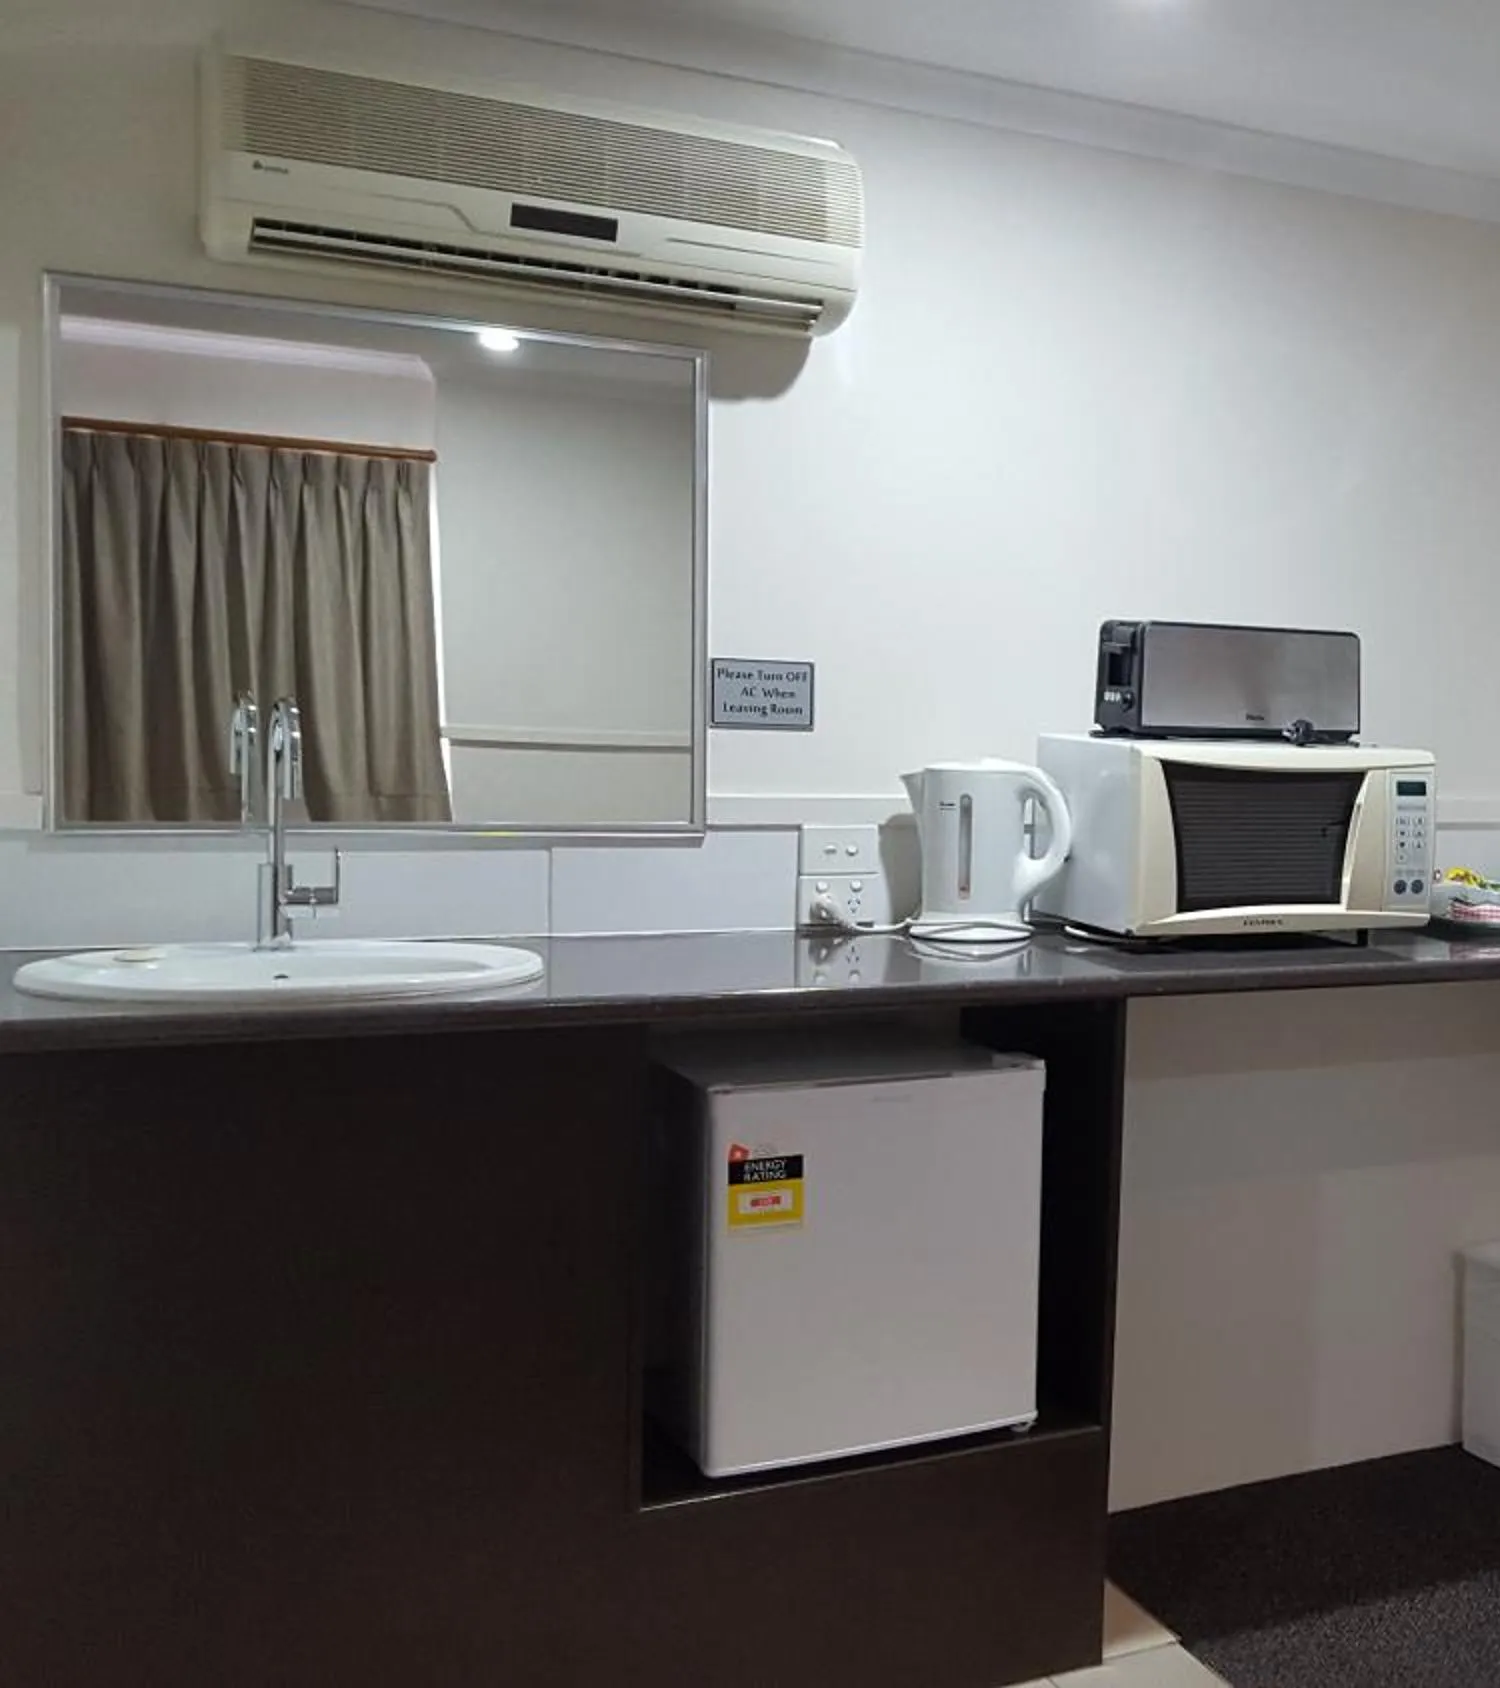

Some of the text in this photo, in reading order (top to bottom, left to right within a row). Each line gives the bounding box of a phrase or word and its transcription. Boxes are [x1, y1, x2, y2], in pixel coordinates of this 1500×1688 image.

[717, 668, 808, 682] Please Turn OFF
[740, 686, 796, 698] AC When
[723, 702, 803, 717] Leaving Room
